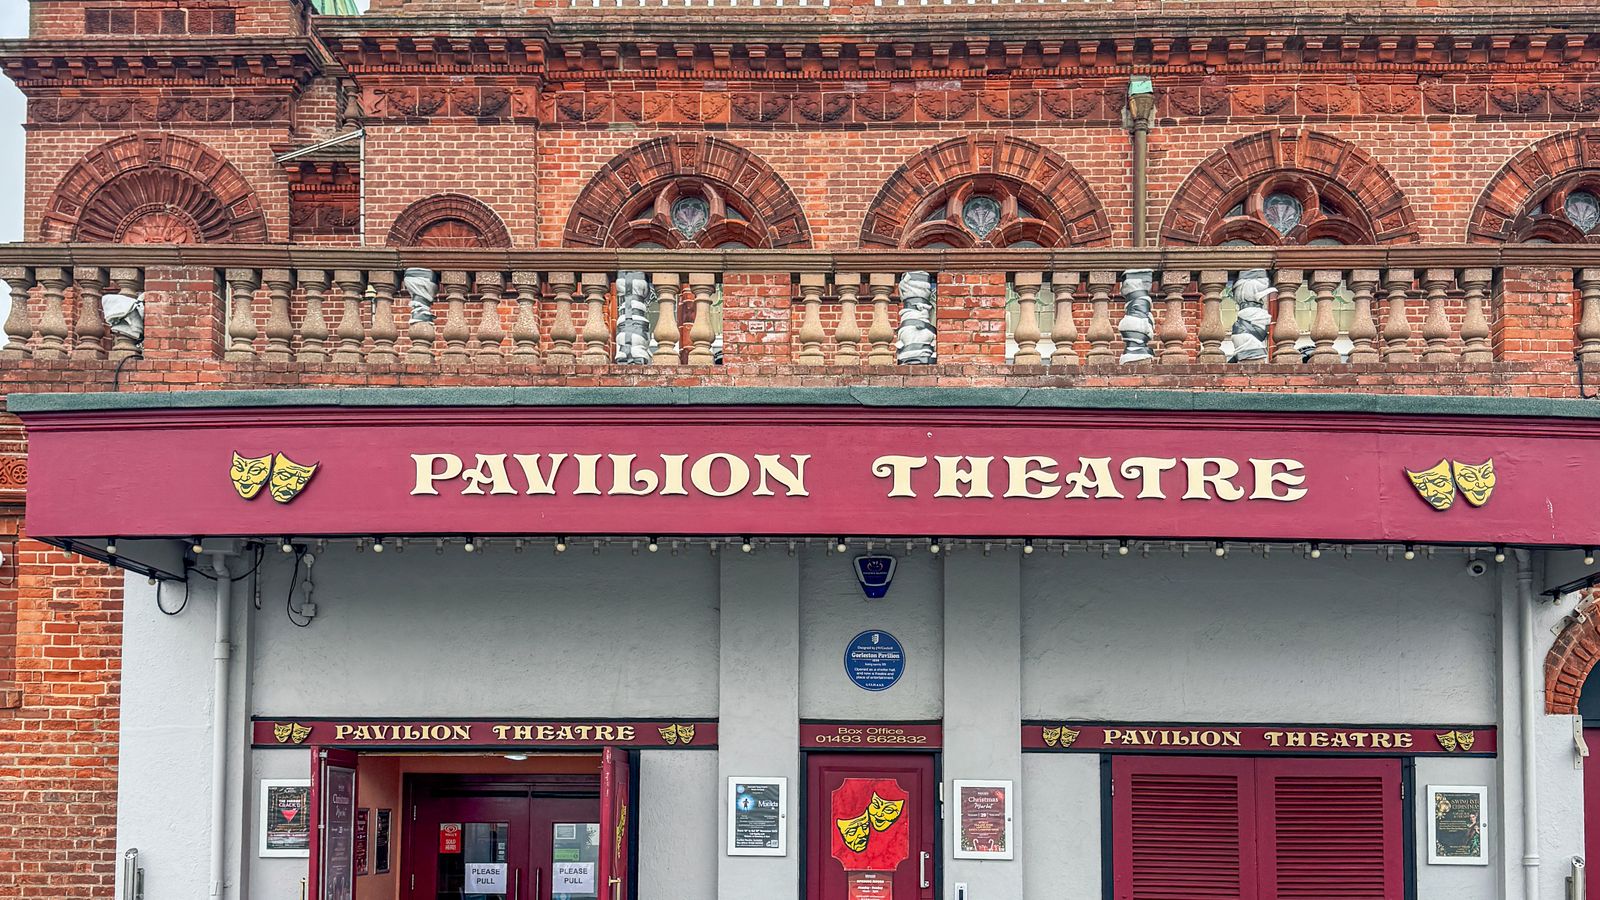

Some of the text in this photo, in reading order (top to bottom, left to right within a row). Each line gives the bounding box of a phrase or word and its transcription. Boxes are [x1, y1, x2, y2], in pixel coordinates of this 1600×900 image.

[410, 452, 1308, 501] PAVILION THEATRE
[335, 724, 636, 741] PAVILION THEATRE
[816, 735, 926, 744] 01493 662832
[1102, 729, 1413, 748] PAVILION THEATRE
